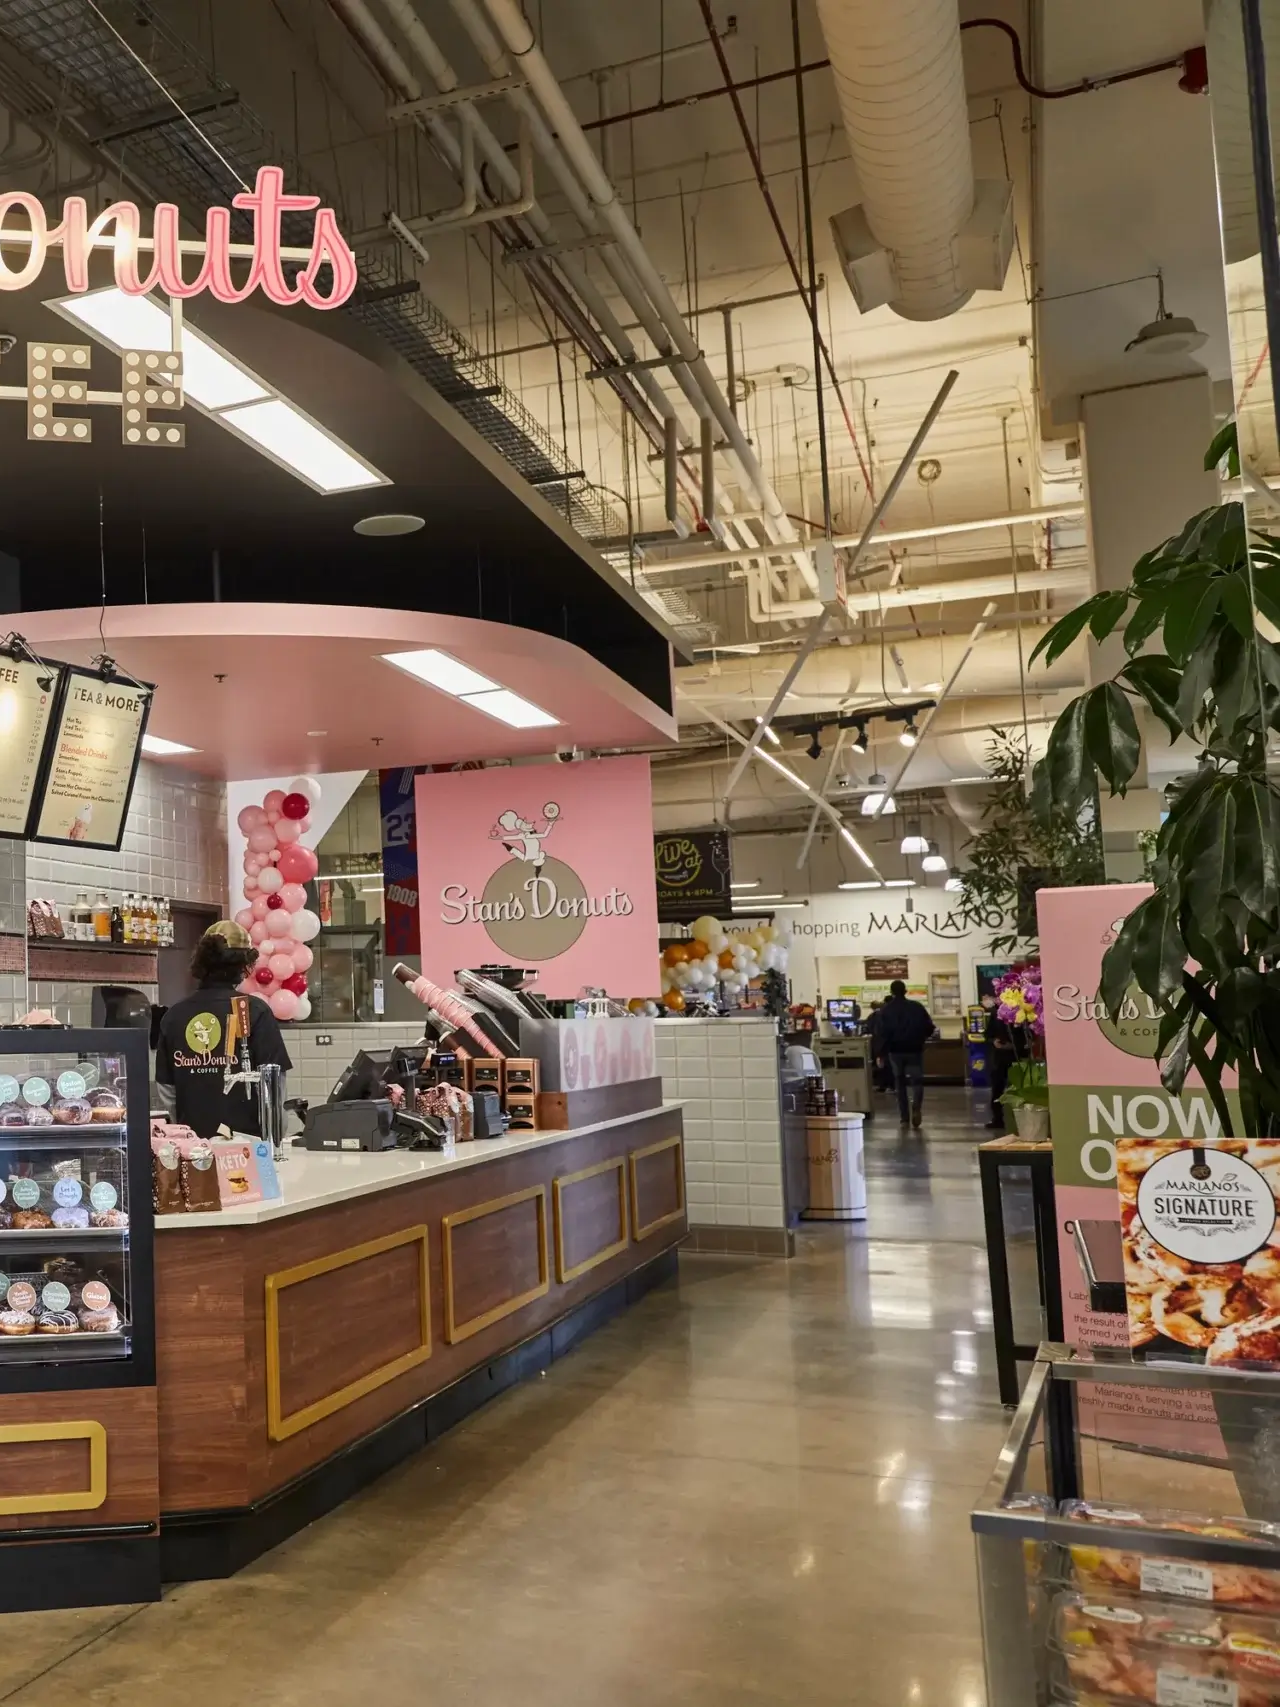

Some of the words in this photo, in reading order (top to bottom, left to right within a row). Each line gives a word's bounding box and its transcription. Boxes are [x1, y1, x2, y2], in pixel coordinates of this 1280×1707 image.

[74, 687, 94, 703] TEA
[95, 693, 103, 705] &
[104, 695, 140, 712] MORE
[61, 743, 87, 756] Blended
[88, 748, 108, 760] Drinks
[440, 883, 526, 924] Stan's
[523, 877, 634, 919] Donuts
[792, 920, 860, 937] hopping
[1052, 984, 1140, 1021] Sta's
[1119, 1028, 1128, 1036] &
[1133, 1028, 1158, 1036] COF
[173, 1050, 202, 1067] Stan's
[1087, 1093, 1221, 1139] NOW
[220, 1153, 248, 1170] KETO
[1166, 1180, 1240, 1195] MARIANO'S
[1154, 1197, 1255, 1217] SIGNATURE
[86, 1292, 107, 1301] Glazed
[1069, 1290, 1089, 1301] Labr
[1074, 1315, 1088, 1324] the
[1090, 1317, 1115, 1328] result
[1078, 1327, 1110, 1338] formed
[1112, 1332, 1129, 1341] yea
[1077, 1395, 1106, 1409] reshly
[1107, 1401, 1135, 1412] made
[1137, 1405, 1171, 1418] donuts
[1174, 1410, 1194, 1420] and
[1193, 1414, 1218, 1425] exc
[1145, 1394, 1183, 1410] serving
[1194, 1402, 1215, 1412] vas
